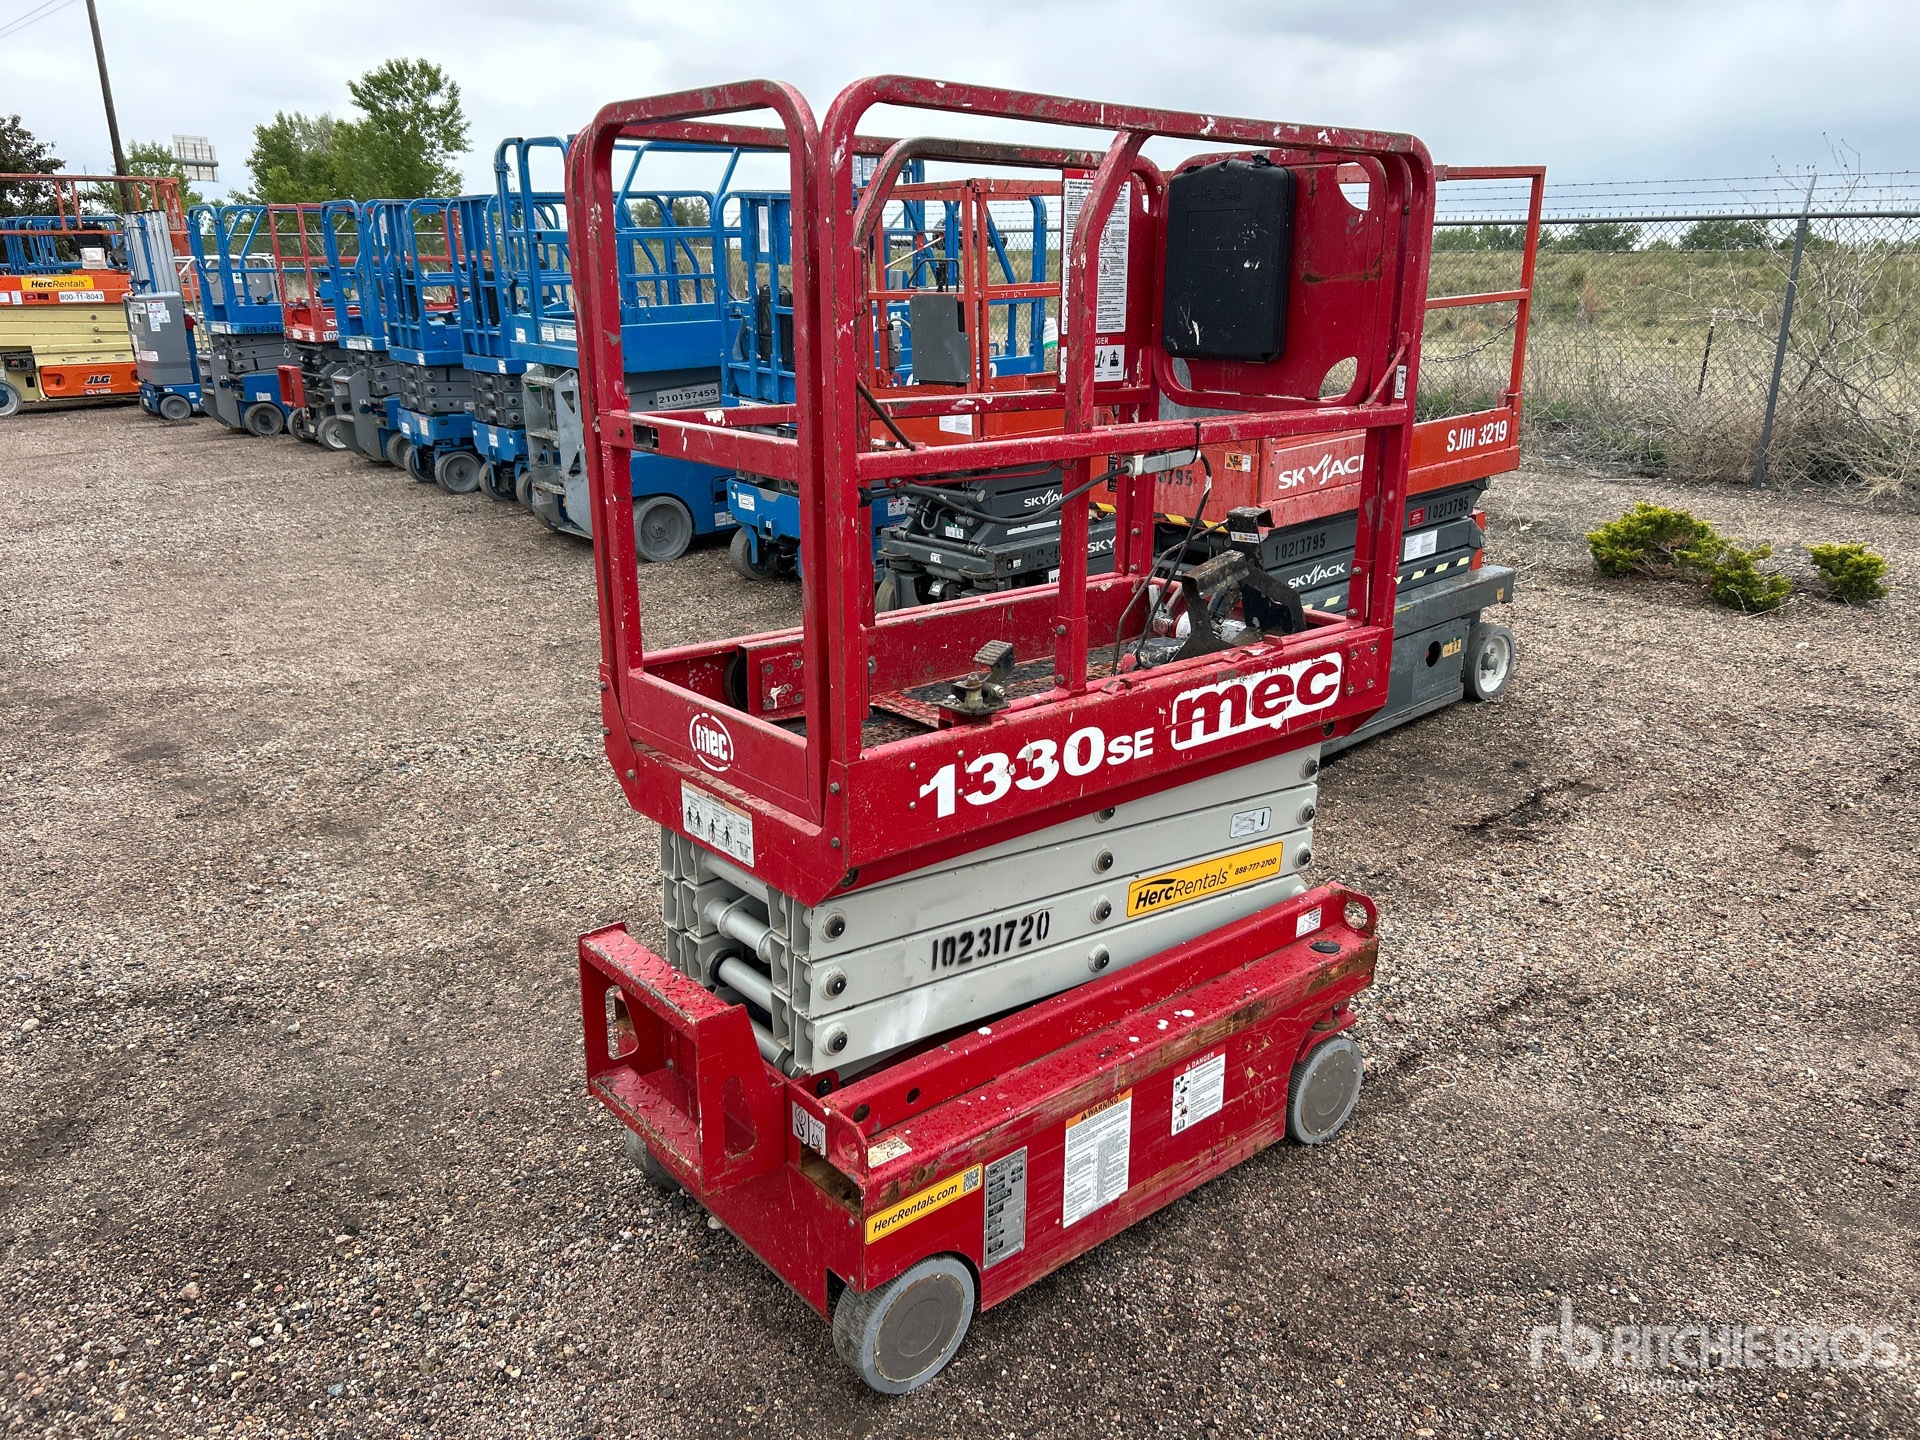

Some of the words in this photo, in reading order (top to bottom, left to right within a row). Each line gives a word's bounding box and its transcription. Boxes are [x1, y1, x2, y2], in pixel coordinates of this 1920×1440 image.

[86, 374, 111, 385] JLG
[658, 388, 717, 404] 210197459
[1478, 419, 1508, 446] 3219
[1023, 489, 1062, 507] SKYJA
[1275, 532, 1326, 561] 10213795
[1287, 563, 1346, 588] SKYJACK
[1234, 857, 1277, 876] 888-777-2700
[931, 910, 1050, 971] 10231720
[1191, 1051, 1215, 1069] DANGER
[1087, 1096, 1119, 1118] WARNING
[873, 1182, 958, 1234] HercRentals.com
